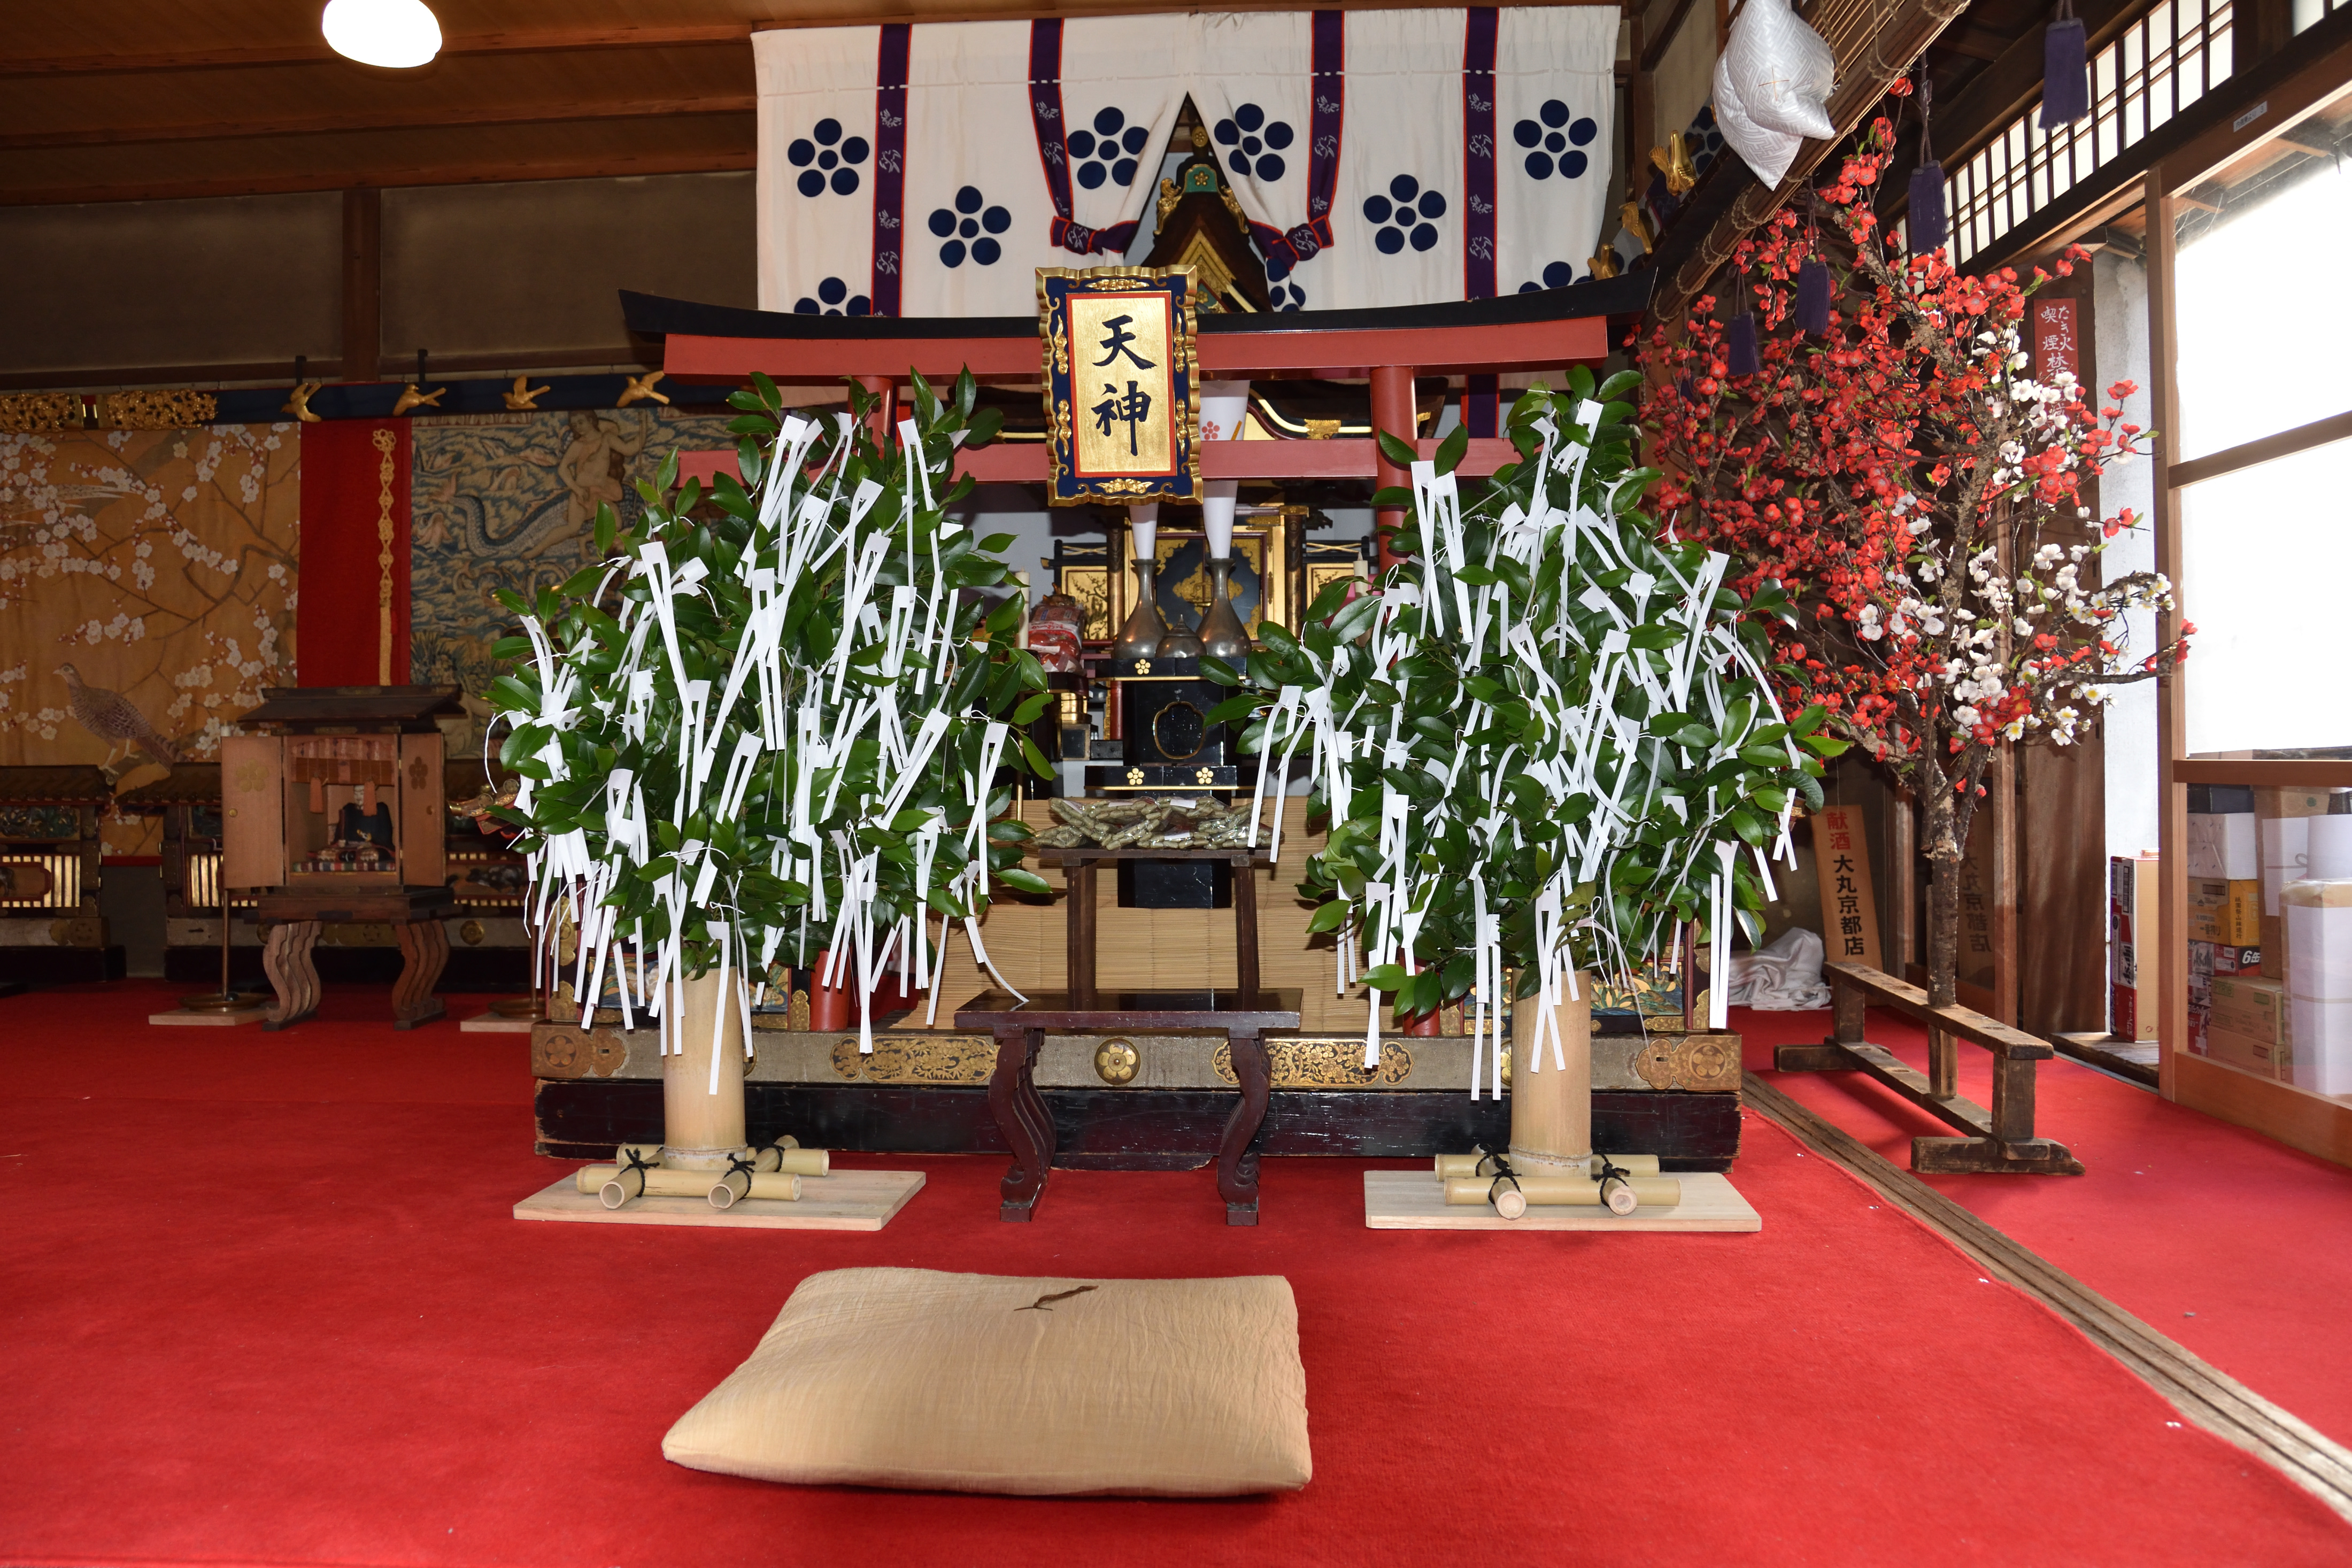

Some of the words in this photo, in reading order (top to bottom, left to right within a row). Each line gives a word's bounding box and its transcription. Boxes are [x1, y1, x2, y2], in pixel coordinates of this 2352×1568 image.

[2040, 306, 2058, 351] 喫煙
[2058, 305, 2075, 351] たき火
[1091, 314, 1157, 457] 天神
[1826, 812, 1851, 850] 献酒
[1833, 854, 1864, 956] 大丸京都店
[2123, 945, 2131, 985] Asahi
